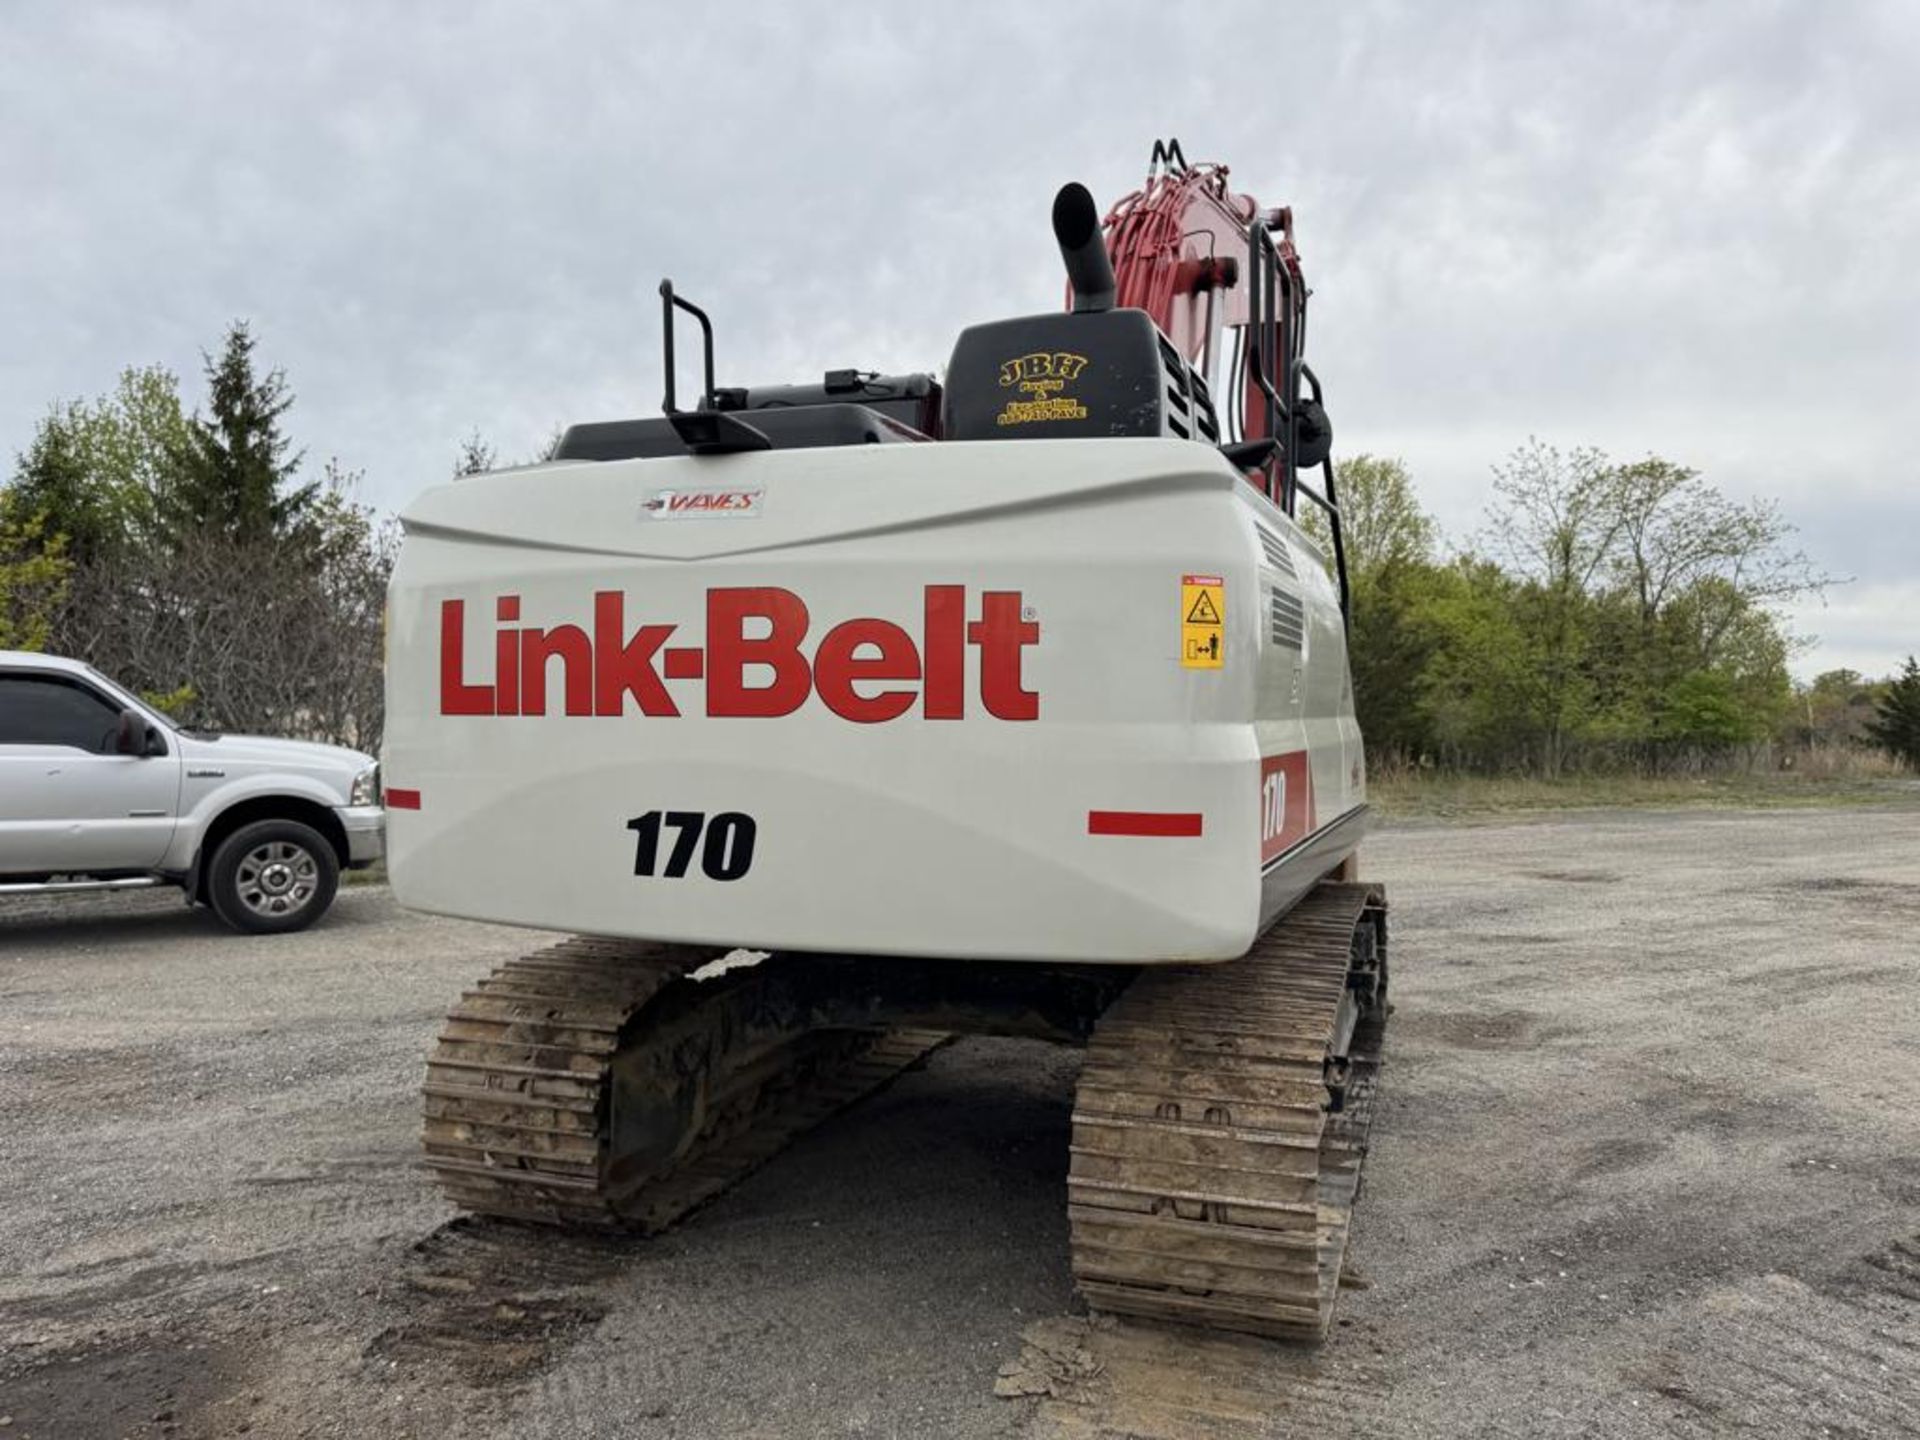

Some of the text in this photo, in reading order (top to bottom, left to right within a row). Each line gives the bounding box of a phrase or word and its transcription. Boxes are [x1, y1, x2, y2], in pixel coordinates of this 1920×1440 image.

[999, 353, 1088, 386] JBH
[668, 493, 755, 511] WAVES
[440, 584, 1040, 722] Link-Belt
[1263, 770, 1286, 840] 170
[626, 811, 757, 881] 170
